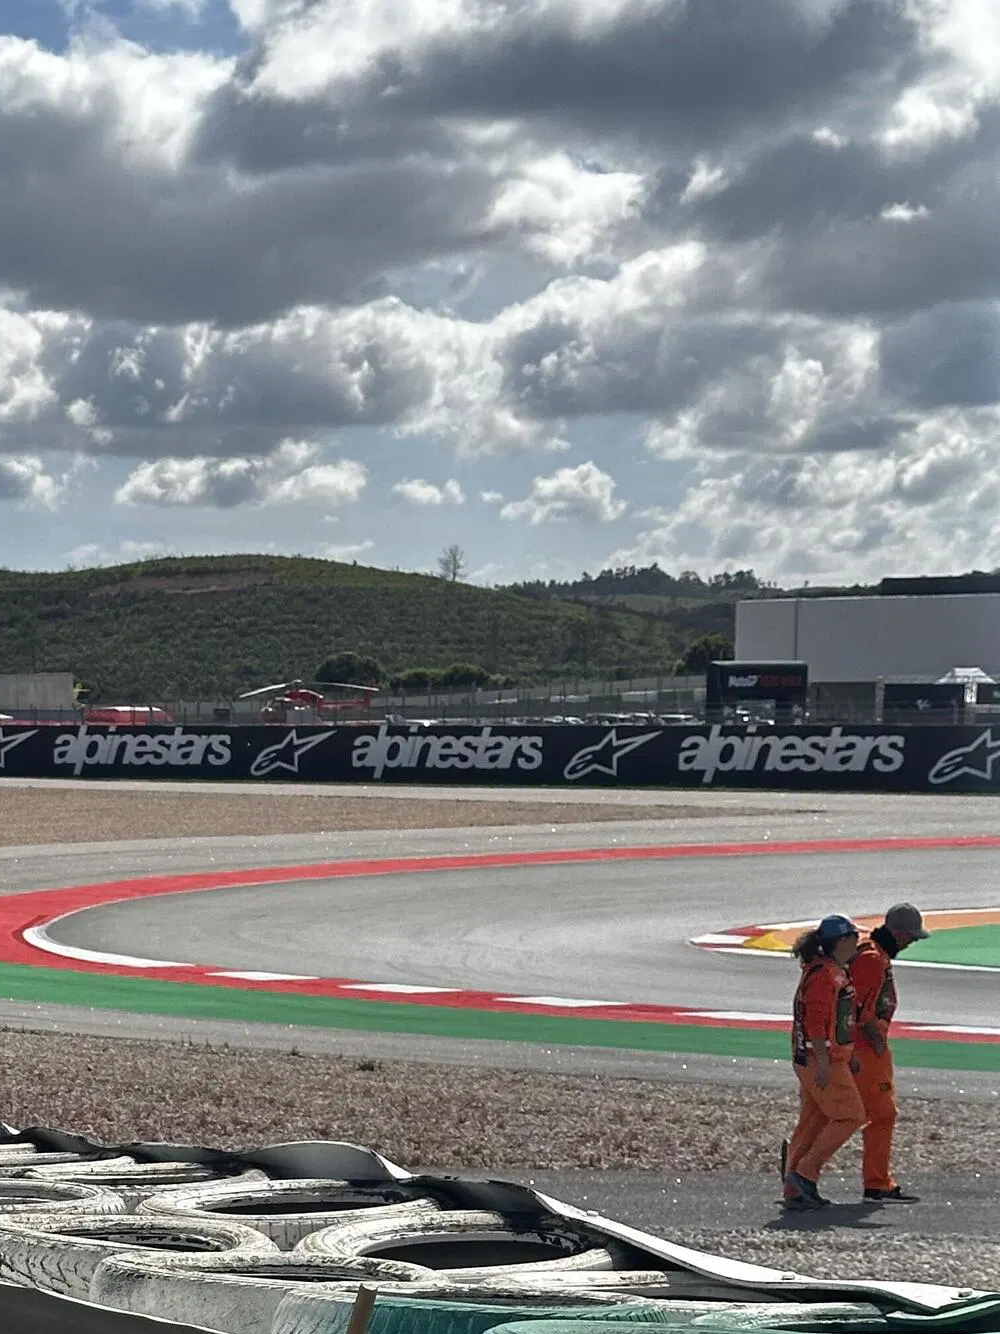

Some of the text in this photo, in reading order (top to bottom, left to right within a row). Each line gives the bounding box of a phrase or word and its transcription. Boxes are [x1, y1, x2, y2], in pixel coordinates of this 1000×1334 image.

[53, 725, 232, 776] alpinestars
[352, 724, 544, 779] alpinestars
[678, 724, 905, 783] alpinestars
